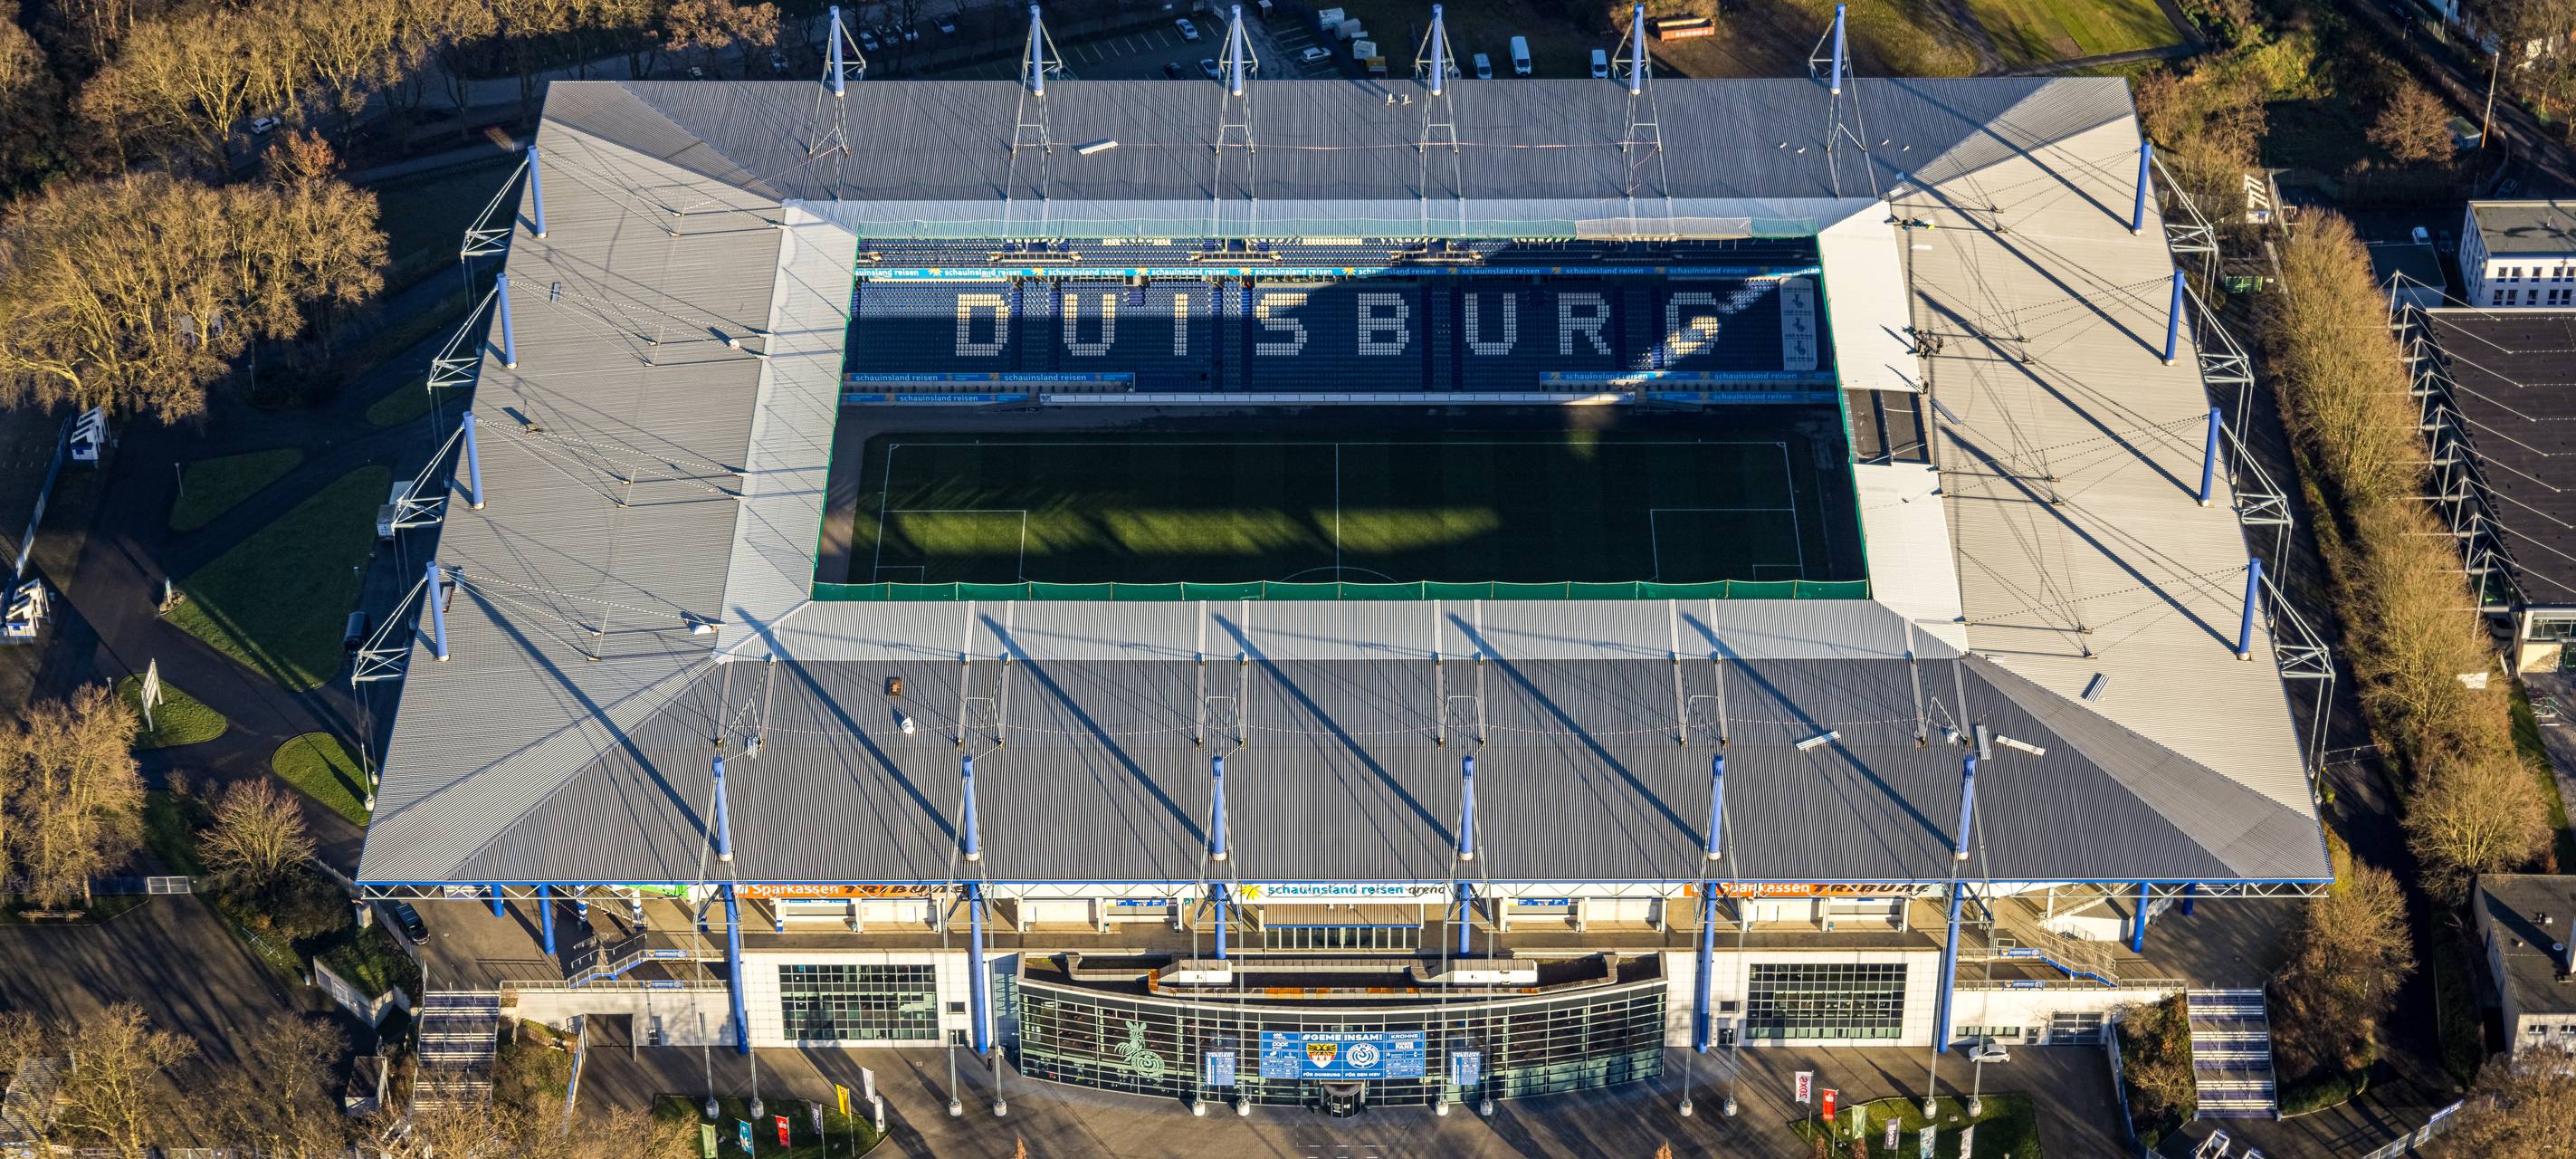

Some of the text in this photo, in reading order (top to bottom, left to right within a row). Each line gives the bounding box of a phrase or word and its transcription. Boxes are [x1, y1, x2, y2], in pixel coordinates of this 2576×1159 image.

[1048, 268, 1125, 276] schauinsland reisen
[1151, 267, 1229, 275] schauinsland reisen
[1255, 267, 1332, 275] schauinsland reisen
[1359, 267, 1436, 275] schauinsland reisen
[1462, 267, 1540, 275] schauinsland reisen
[1565, 267, 1644, 275] schauinsland reisen
[956, 292, 1720, 356] DUISBURG
[855, 373, 938, 381] schauinsland reisen
[1004, 373, 1087, 381] schauinsland reisen
[1566, 372, 1619, 380] schauinsland
[1622, 372, 1648, 380] reisen
[1714, 372, 1797, 380] schauinsland reisen
[900, 394, 978, 402] schauinsland reisen
[1713, 392, 1792, 400] schauinsland reisen
[752, 884, 838, 896] Sparkassen
[1268, 884, 1445, 896] schauinsland reisen arena
[1721, 883, 1810, 895] Sparkassen
